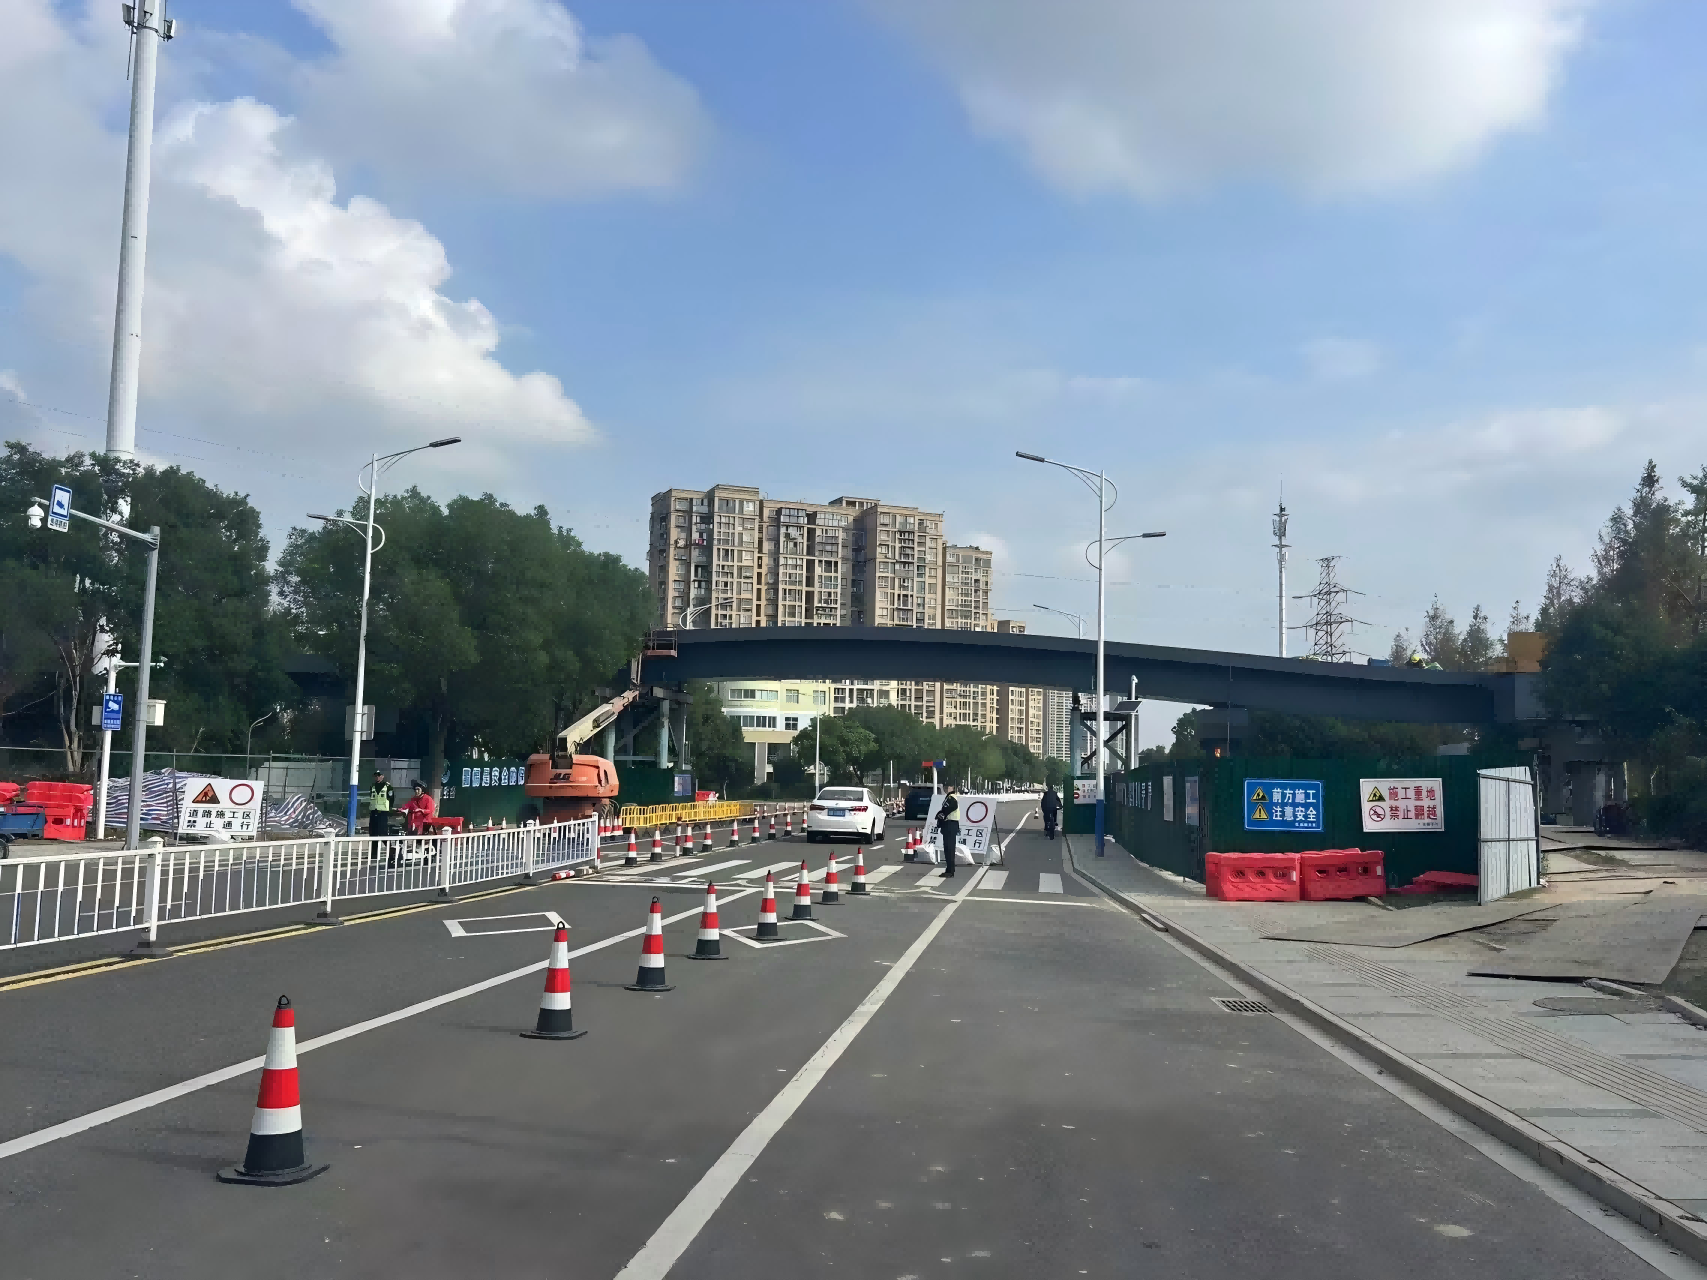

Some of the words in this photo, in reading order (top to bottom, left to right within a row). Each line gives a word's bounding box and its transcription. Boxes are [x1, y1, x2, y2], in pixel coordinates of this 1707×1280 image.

[1272, 787, 1317, 802] 前方施工
[1388, 785, 1436, 801] 施工重地
[187, 809, 252, 820] 道路施工区
[1272, 805, 1317, 821] 注意安全
[1388, 804, 1438, 820] 禁止翻越
[186, 819, 251, 831] 禁止通行
